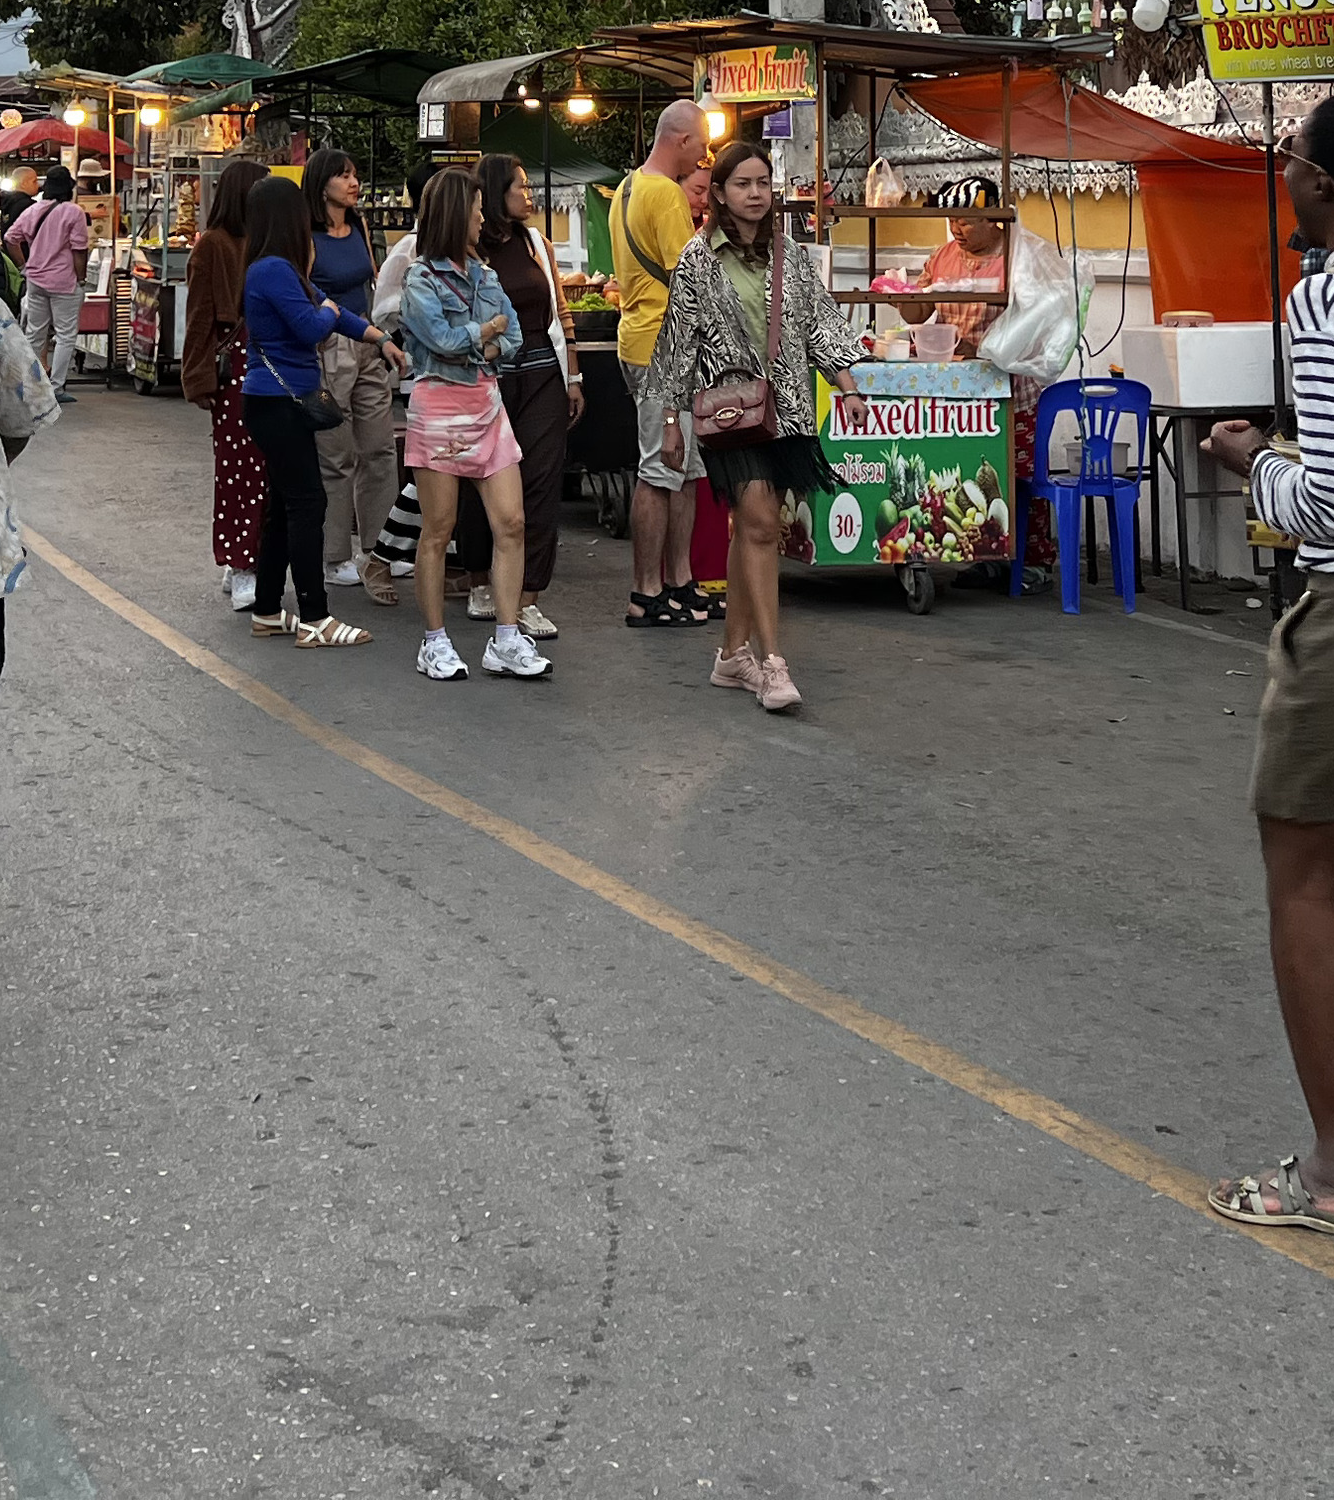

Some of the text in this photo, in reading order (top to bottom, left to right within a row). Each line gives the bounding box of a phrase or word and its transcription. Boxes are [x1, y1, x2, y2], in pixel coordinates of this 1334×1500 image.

[763, 51, 808, 91] fruit
[1248, 56, 1277, 71] whole
[1280, 54, 1312, 71] wheat
[928, 397, 997, 435] fruit
